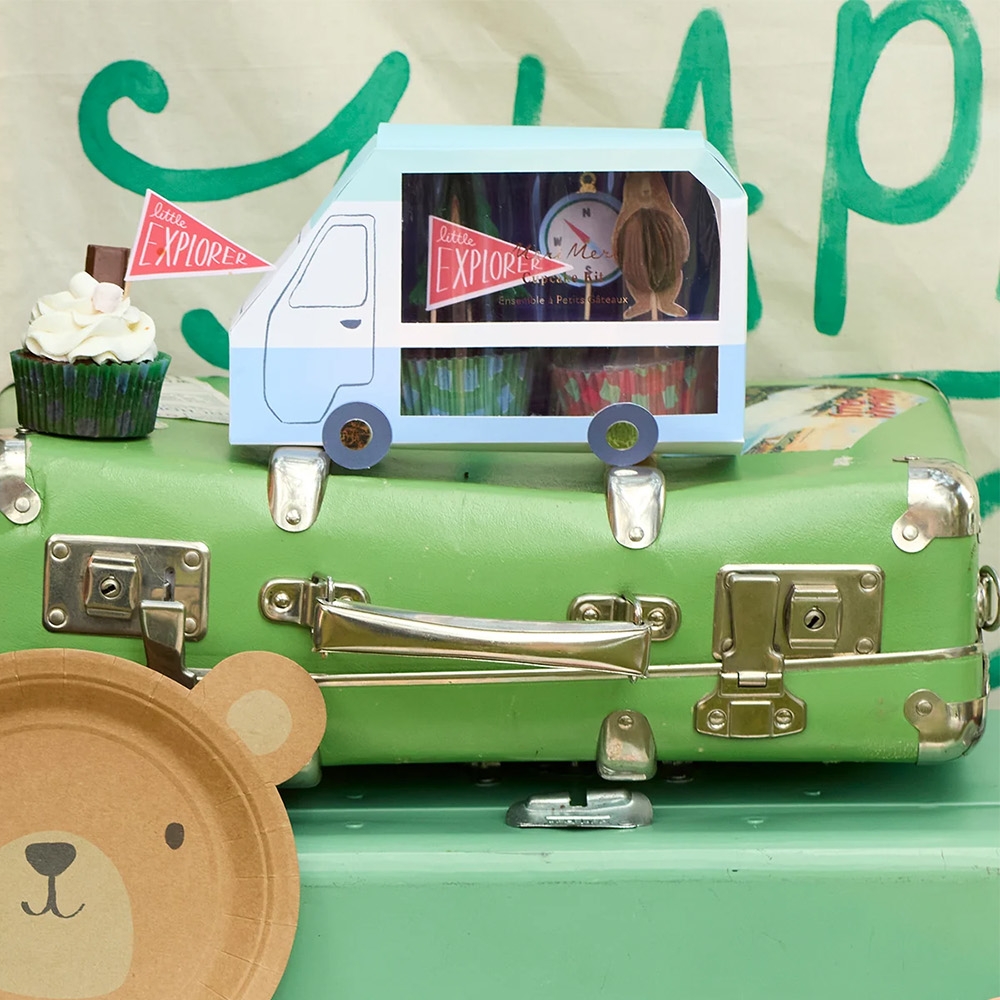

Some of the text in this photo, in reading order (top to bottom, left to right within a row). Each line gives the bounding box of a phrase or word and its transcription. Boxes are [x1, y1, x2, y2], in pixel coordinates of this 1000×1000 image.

[150, 202, 187, 229] little
[582, 207, 591, 218] N
[138, 221, 248, 267] EXPLORER
[436, 225, 476, 247] little
[436, 246, 543, 293] EXPLORER
[556, 295, 585, 305] Petits
